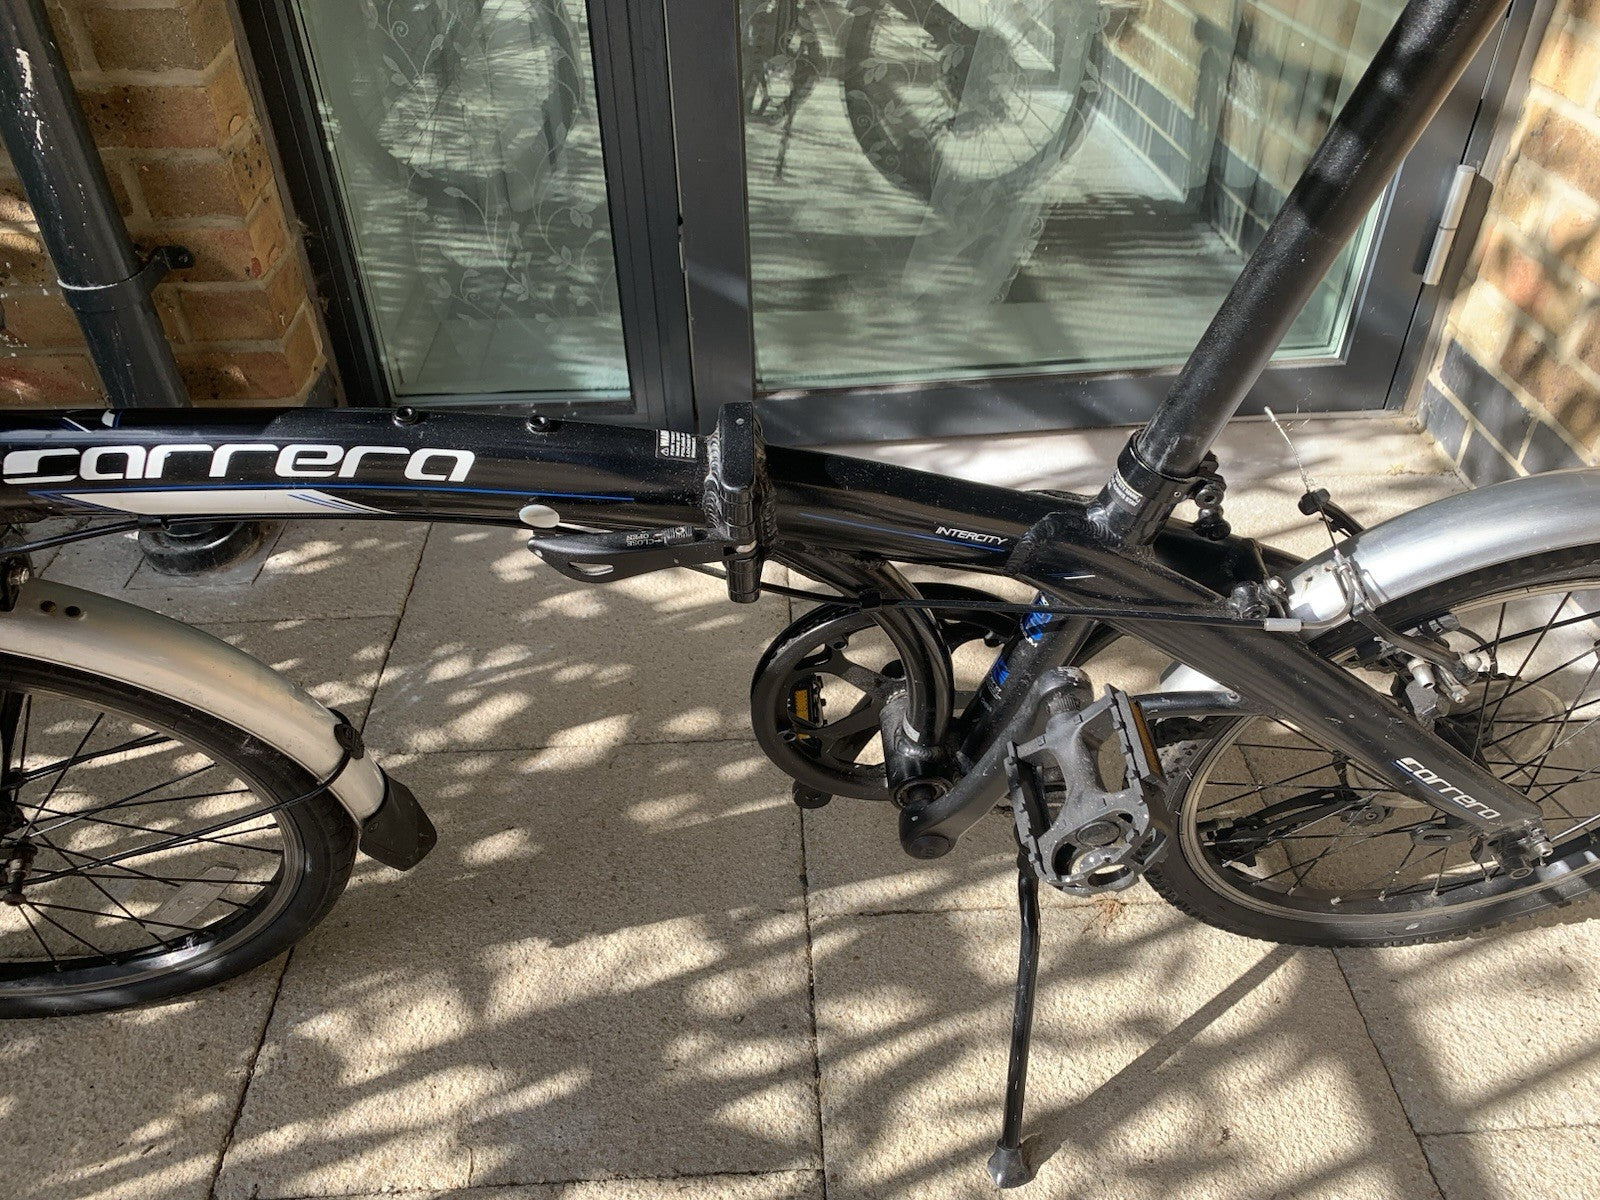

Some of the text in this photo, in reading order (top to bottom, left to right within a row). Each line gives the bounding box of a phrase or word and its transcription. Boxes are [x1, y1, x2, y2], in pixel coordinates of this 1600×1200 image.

[2, 443, 476, 485] carrera
[935, 526, 1009, 545] INTERCITY
[1395, 757, 1501, 819] carrera
